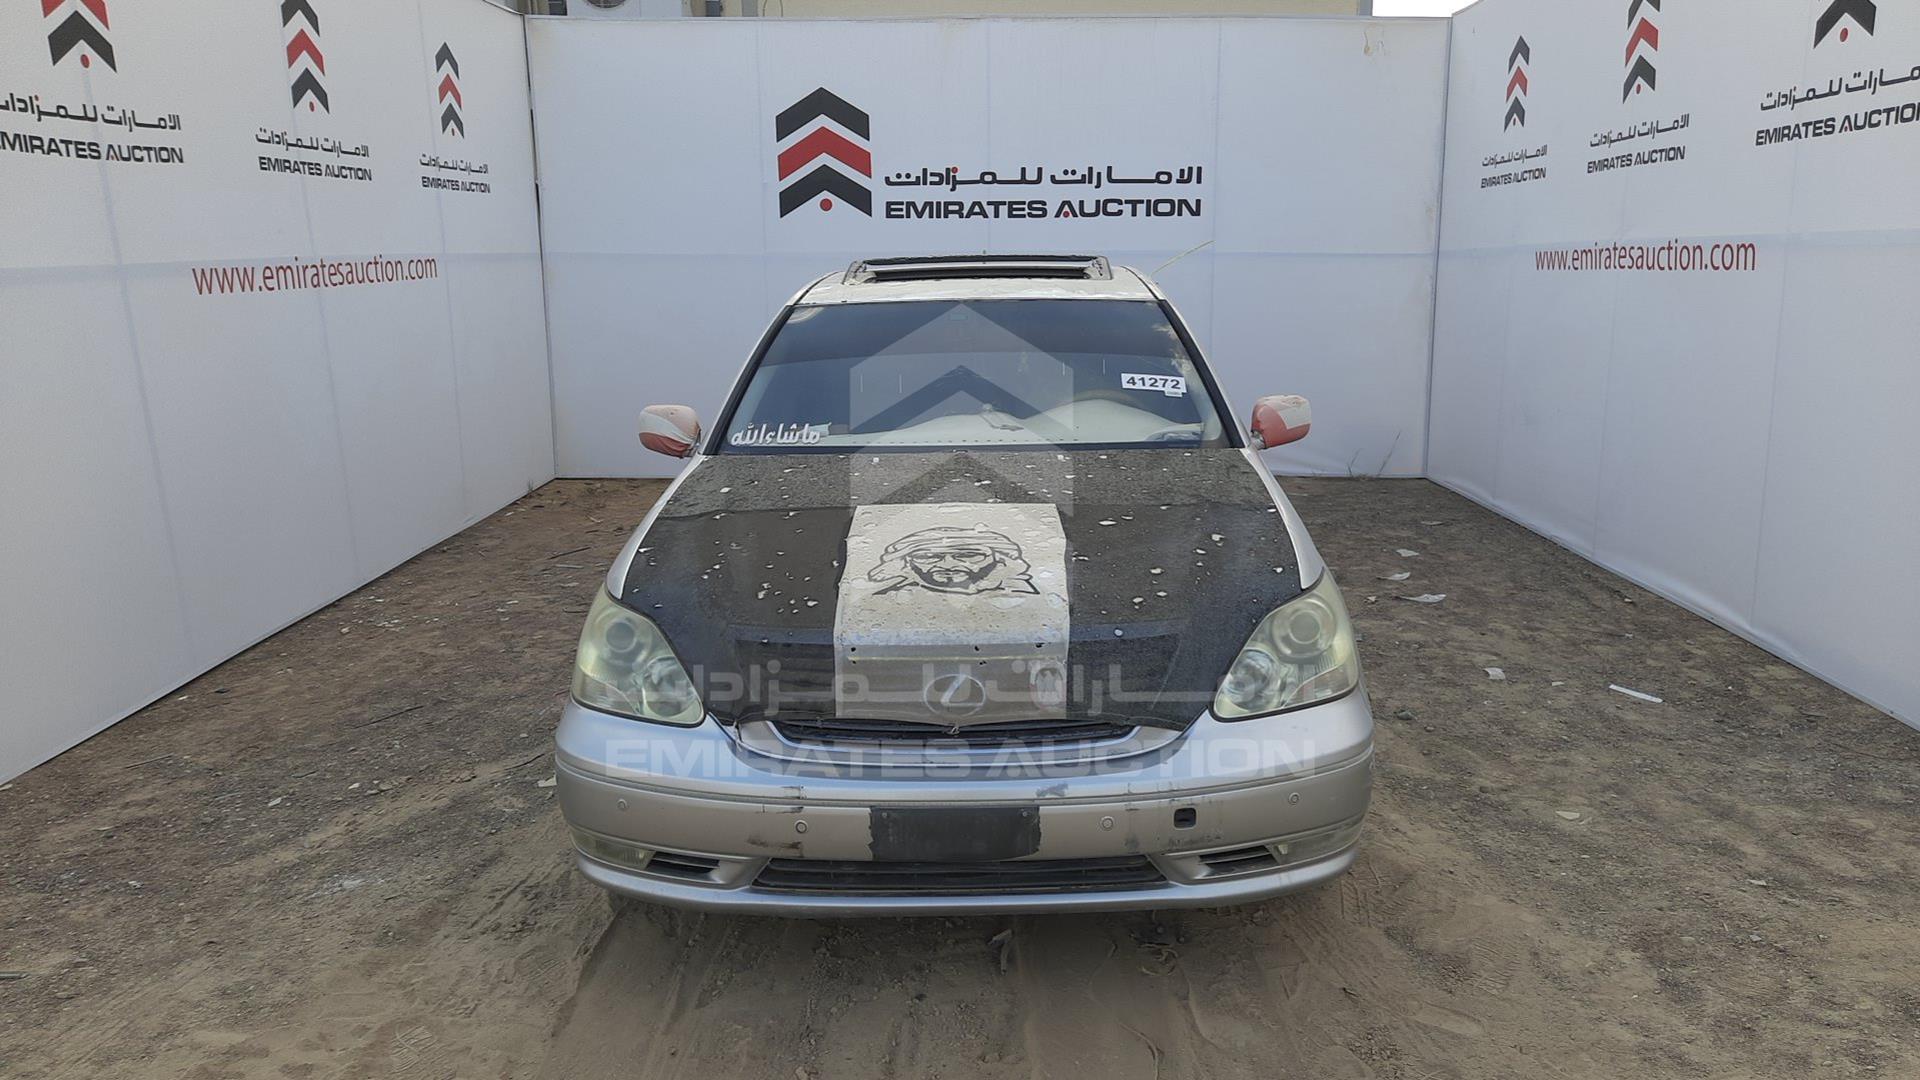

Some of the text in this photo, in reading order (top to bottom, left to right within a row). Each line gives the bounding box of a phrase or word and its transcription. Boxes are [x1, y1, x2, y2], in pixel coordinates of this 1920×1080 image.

[1761, 77, 1843, 111] للمزادات
[101, 105, 181, 132] الامارات
[1590, 113, 1690, 148] الامارات للمزادات
[1755, 117, 1836, 146] EMIRATES
[0, 131, 184, 163] MIRATES AUCTION
[256, 127, 369, 158] الامارات للمزادات
[258, 156, 373, 181] EMIRATES AUCTION
[1587, 146, 1686, 174] EMIRATES AUCTION
[421, 176, 491, 193] EMIRATES AUCTION
[884, 165, 1203, 191] الامارات للمزادات
[1480, 167, 1547, 188] EMIRATES AUCTION
[885, 198, 1202, 219] EMIRATES AUCTION
[1535, 239, 1756, 271] www.emiratesauction.com
[192, 254, 438, 295] www.emiratesauction.com
[1126, 376, 1181, 389] 41272
